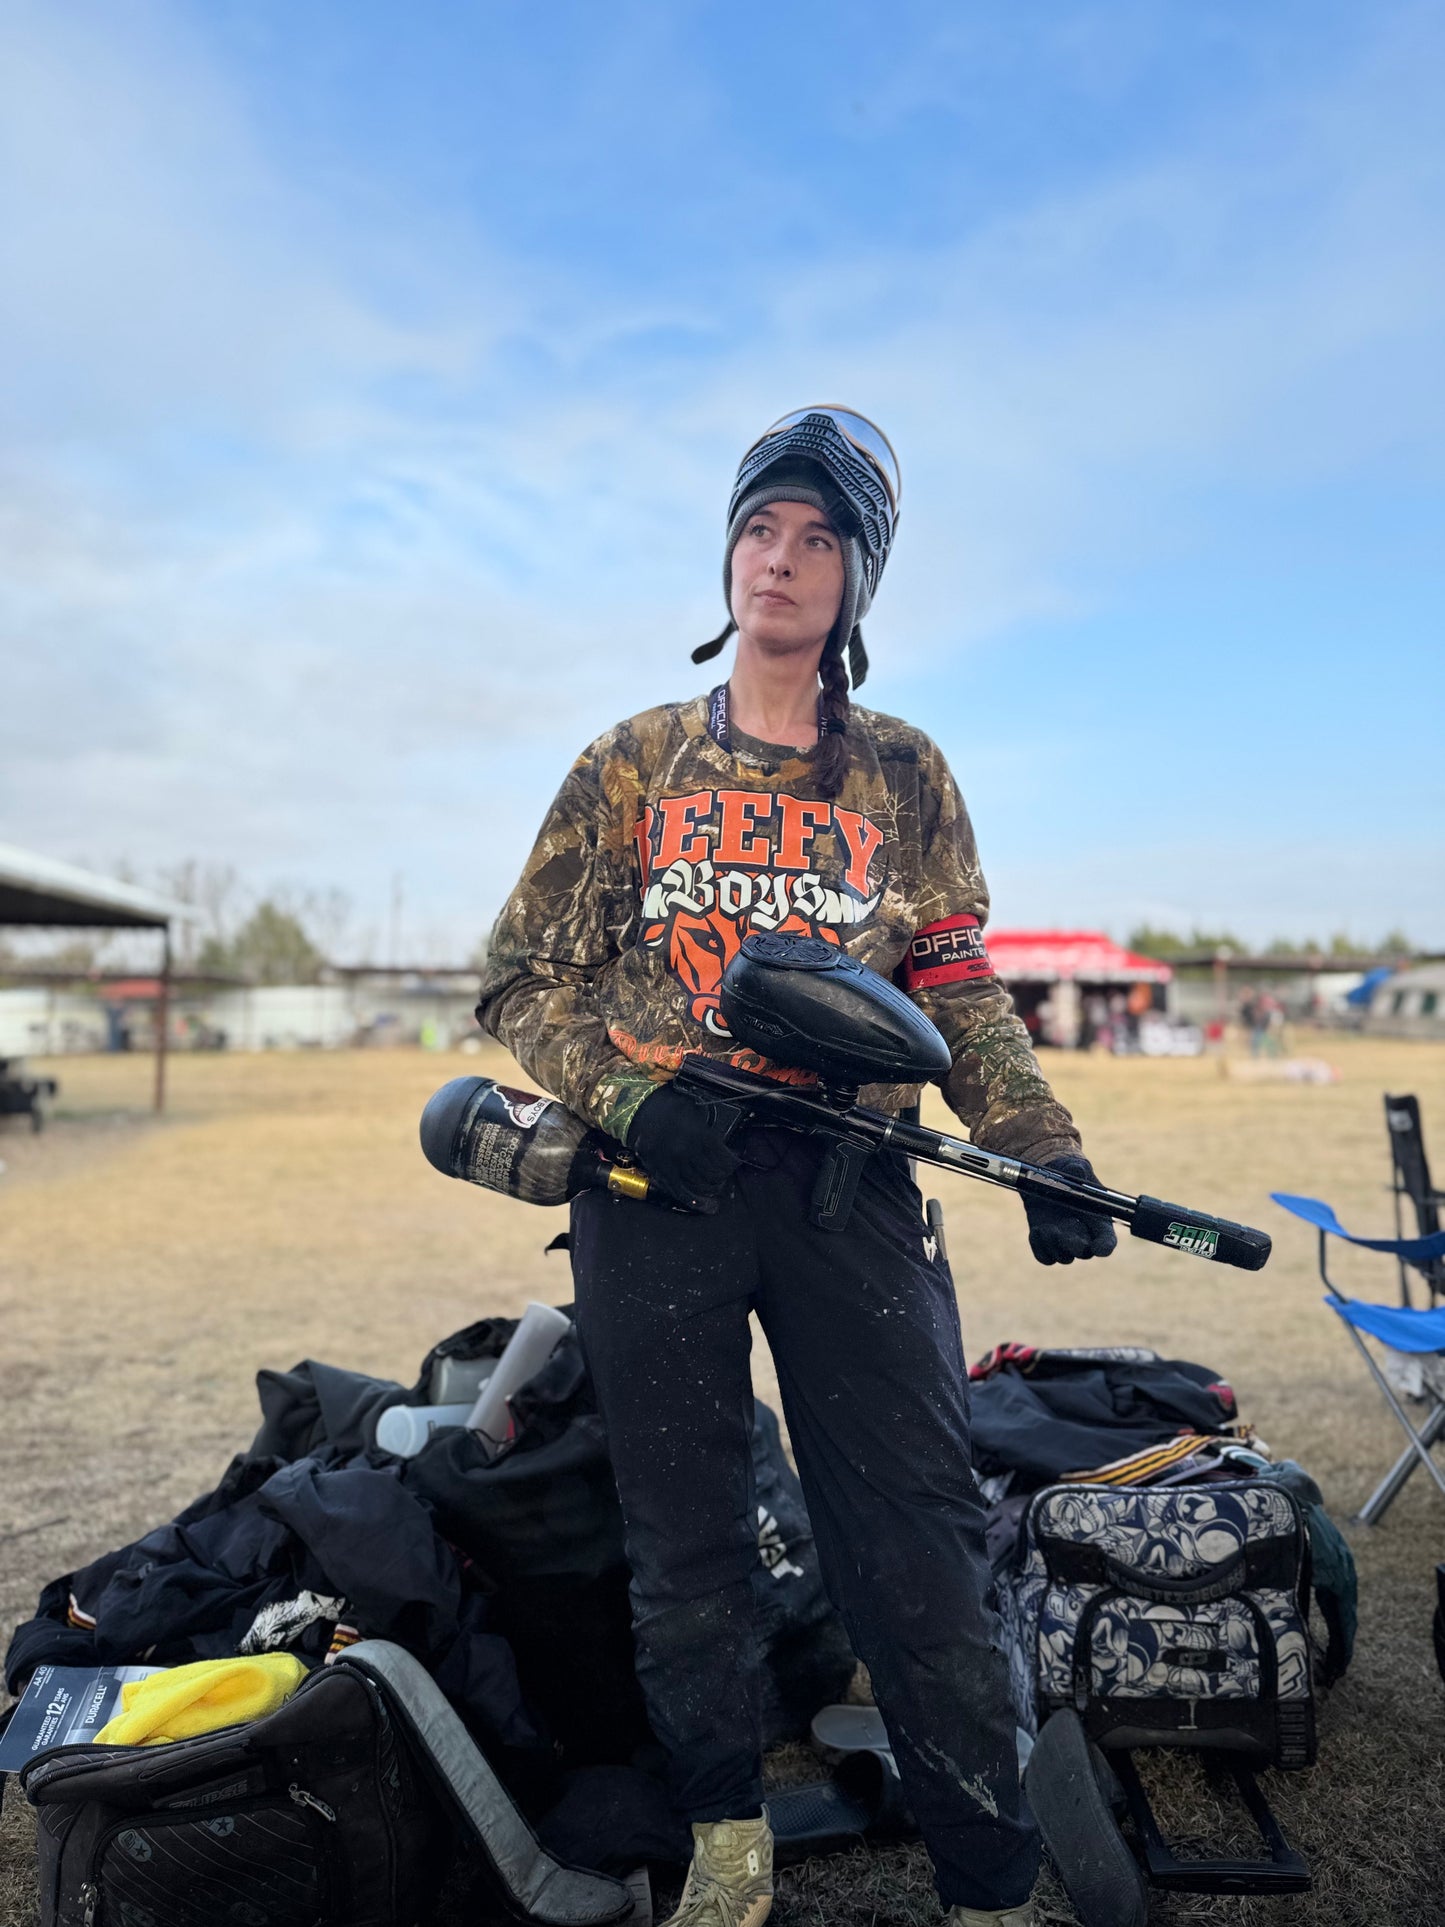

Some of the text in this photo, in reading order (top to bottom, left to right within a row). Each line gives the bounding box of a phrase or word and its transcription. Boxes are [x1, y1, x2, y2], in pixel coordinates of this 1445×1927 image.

[716, 689, 727, 739] OFFICIAL
[941, 947, 987, 963] PAINTB
[1164, 1222, 1219, 1253] VIBE
[46, 1702, 65, 1716] 12
[54, 1687, 65, 1704] YEARS
[85, 1685, 108, 1724] DURACELL
[31, 1716, 51, 1751] GUARANTEED
